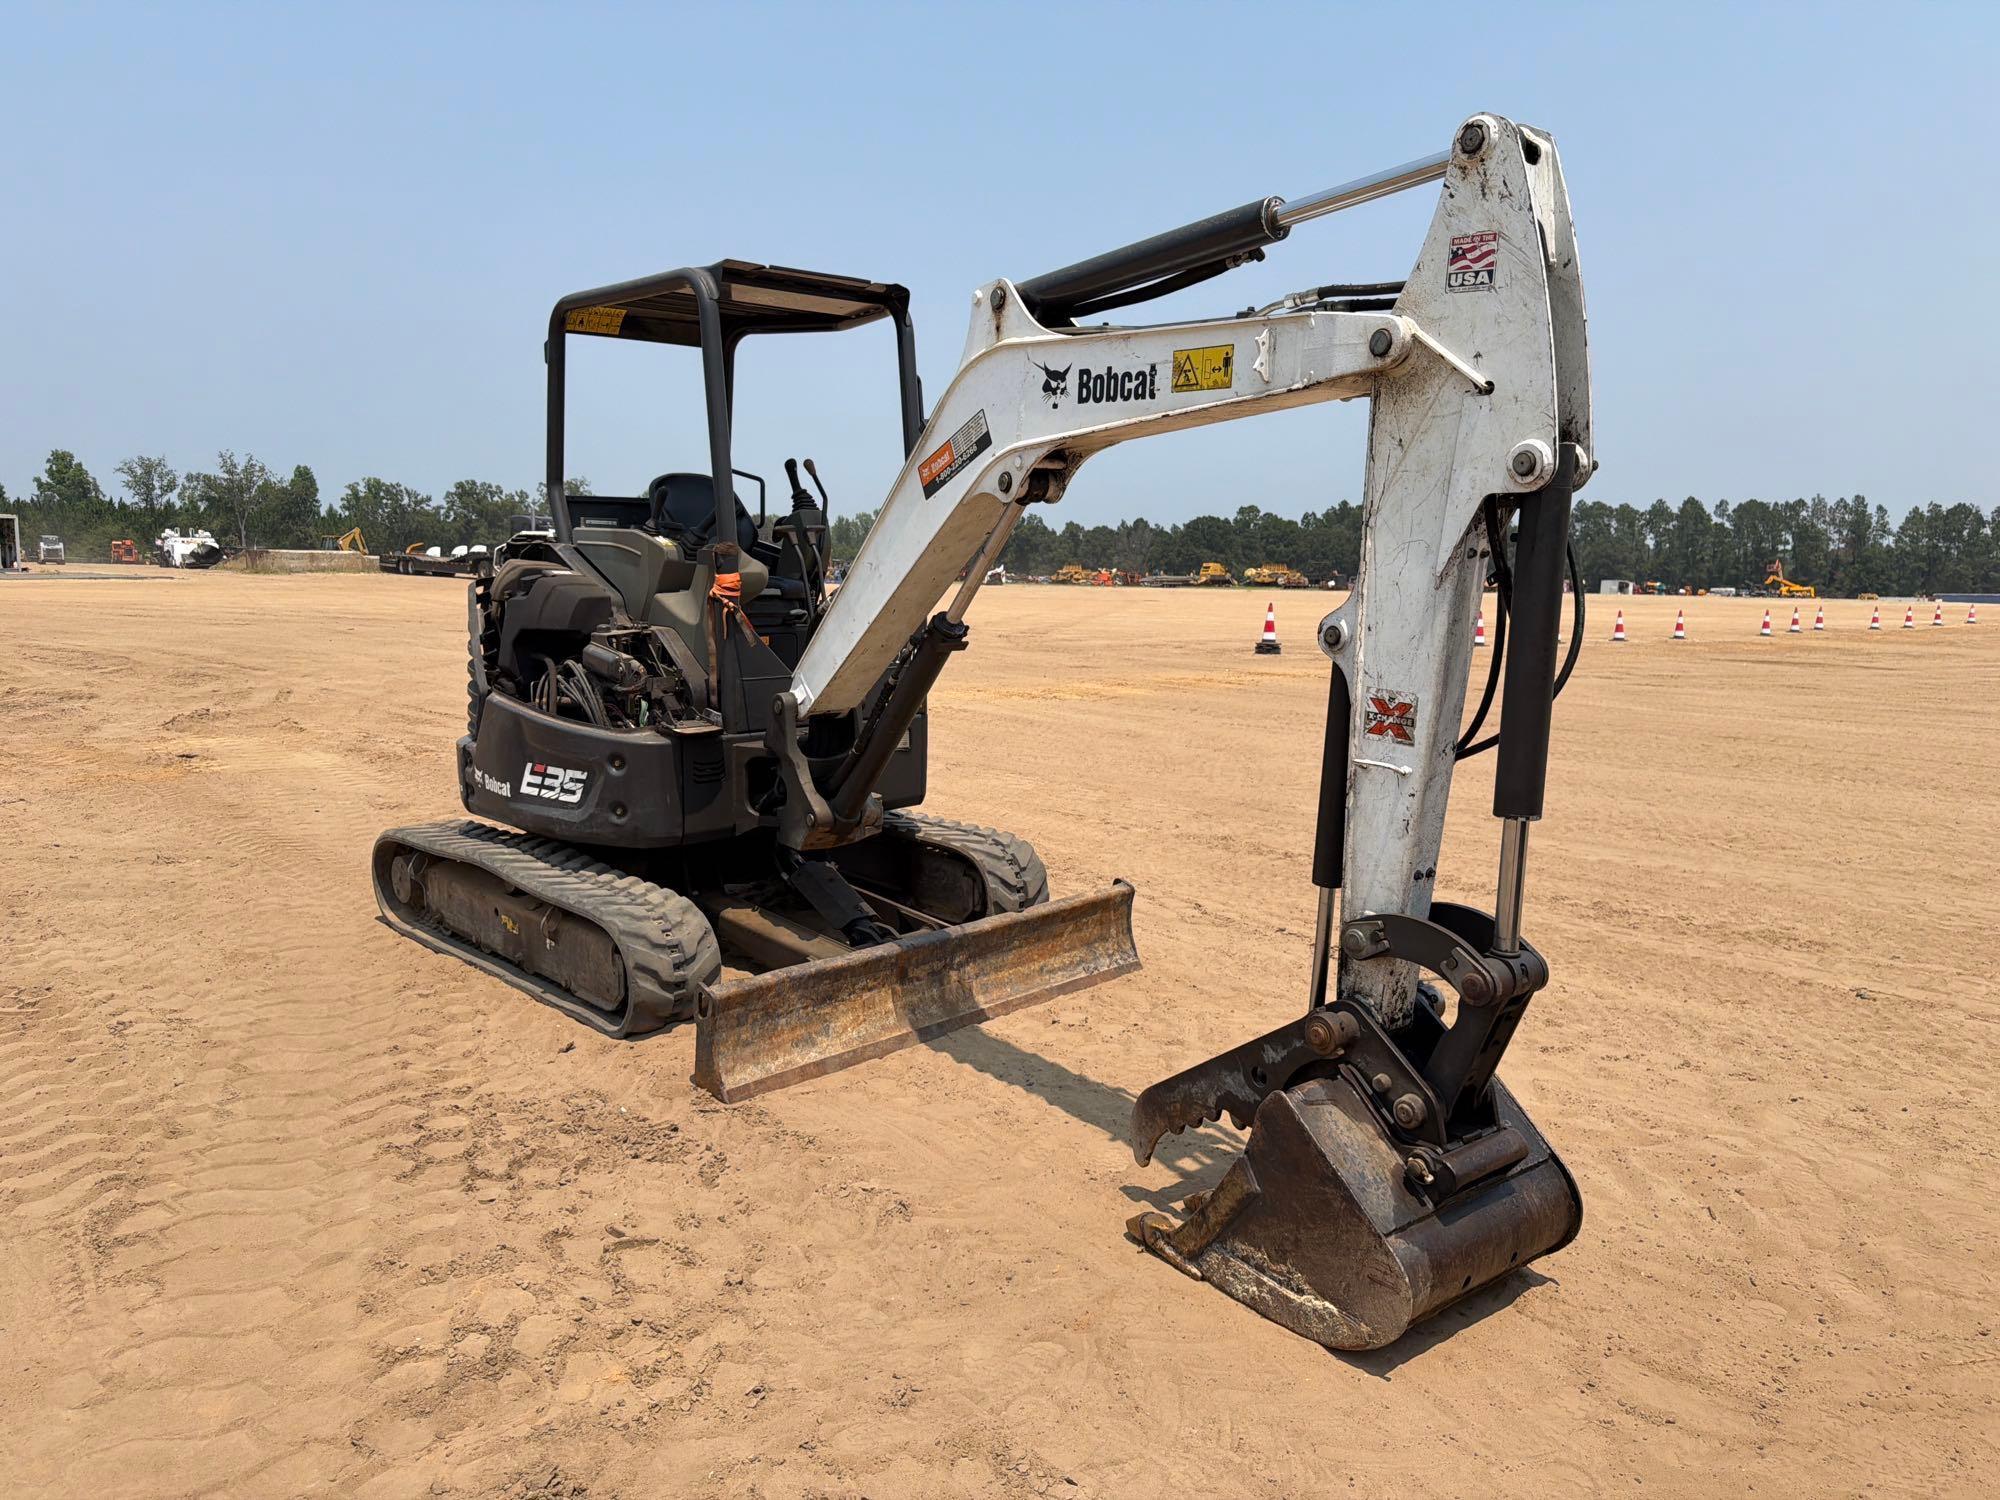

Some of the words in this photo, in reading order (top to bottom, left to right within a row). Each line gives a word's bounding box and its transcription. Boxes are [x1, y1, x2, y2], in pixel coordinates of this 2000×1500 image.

[1453, 236, 1472, 245] MADE
[1482, 234, 1495, 242] THE
[1449, 271, 1490, 287] USA
[1077, 363, 1158, 405] Bobcat
[484, 773, 512, 798] Bobcat
[519, 761, 588, 804] E35
